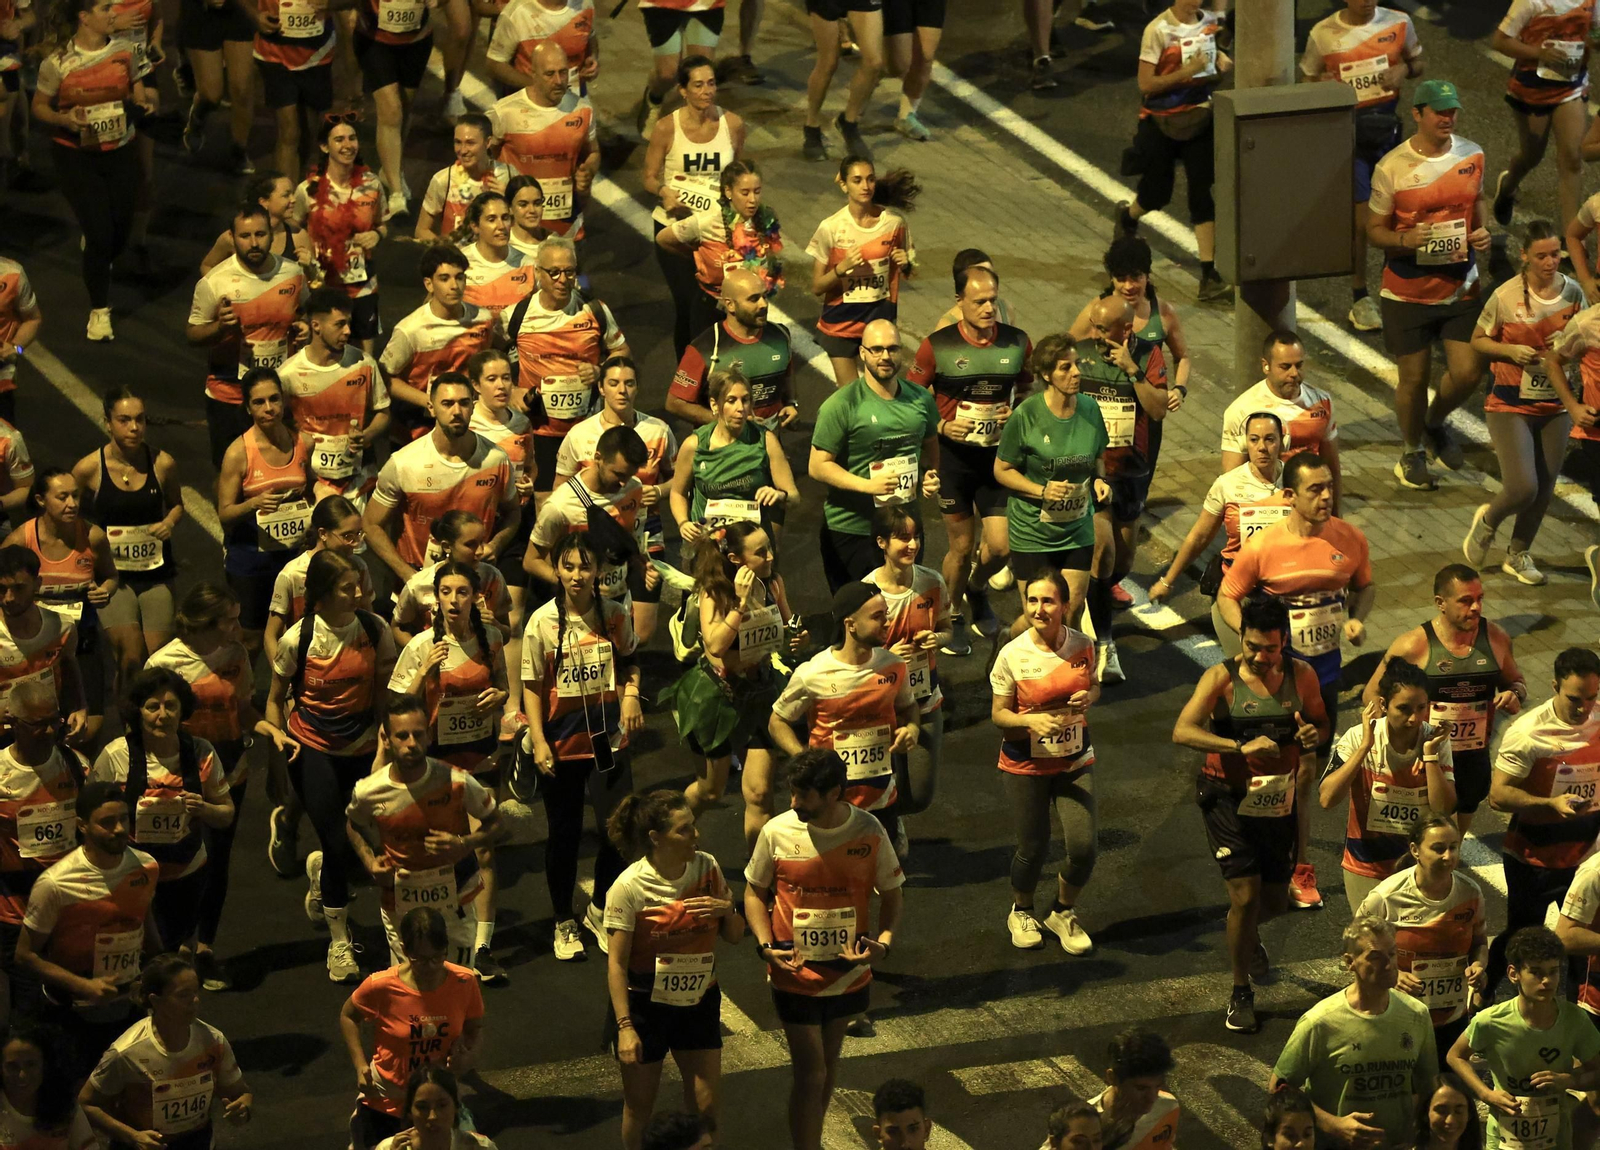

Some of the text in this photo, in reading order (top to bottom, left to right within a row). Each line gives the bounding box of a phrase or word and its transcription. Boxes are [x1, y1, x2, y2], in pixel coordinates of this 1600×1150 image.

[287, 15, 316, 28] 9384
[387, 10, 415, 23] 9380
[1349, 73, 1384, 91] 18848
[683, 152, 720, 173] HH
[678, 190, 711, 211] 2460
[847, 274, 885, 292] 21759
[550, 392, 583, 408] 9735
[972, 420, 997, 435] 207
[476, 477, 494, 488] KH7
[1047, 495, 1086, 513] 23032
[264, 519, 305, 540] 11884
[1246, 525, 1263, 538] 22
[114, 542, 156, 559] 11882
[744, 625, 778, 646] 11720
[1298, 623, 1337, 644] 11883
[562, 663, 607, 685] 20667
[878, 675, 894, 685] KH7
[842, 746, 884, 765] 21255
[1253, 791, 1287, 807] 3964
[1379, 805, 1419, 821] 4036
[152, 816, 181, 830] 614
[35, 823, 63, 842] 662
[847, 846, 866, 857] KH7
[401, 885, 450, 904] 21063
[800, 928, 848, 947] 19319
[662, 973, 706, 993] 19327
[1419, 976, 1463, 998] 21578
[408, 1040, 442, 1056] TUR
[1354, 1074, 1405, 1092] sano
[161, 1094, 207, 1121] 12146
[1511, 1118, 1549, 1138] 1817
